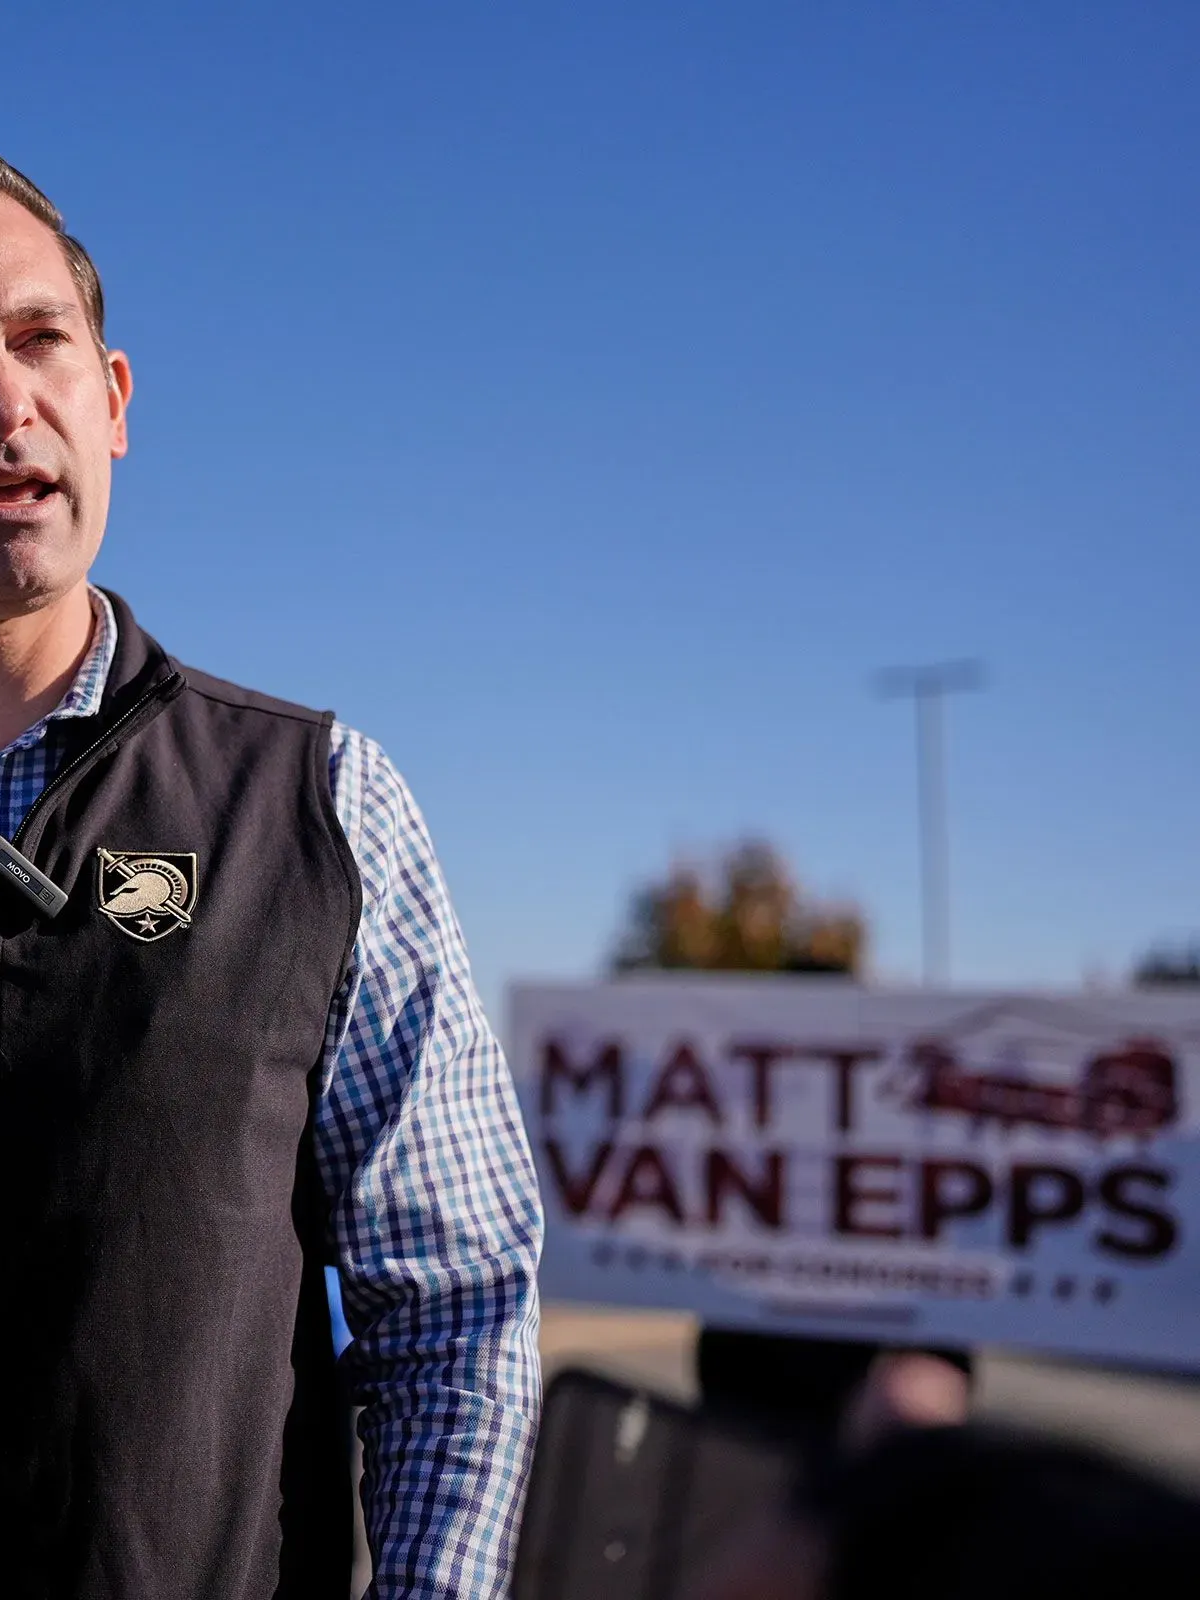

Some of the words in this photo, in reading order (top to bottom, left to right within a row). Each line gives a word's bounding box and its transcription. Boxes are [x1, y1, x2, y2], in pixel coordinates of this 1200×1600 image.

[6, 862, 31, 883] MOVO
[539, 1037, 881, 1135] MATT
[540, 1137, 785, 1232] VAN
[831, 1154, 1179, 1262] EPPS
